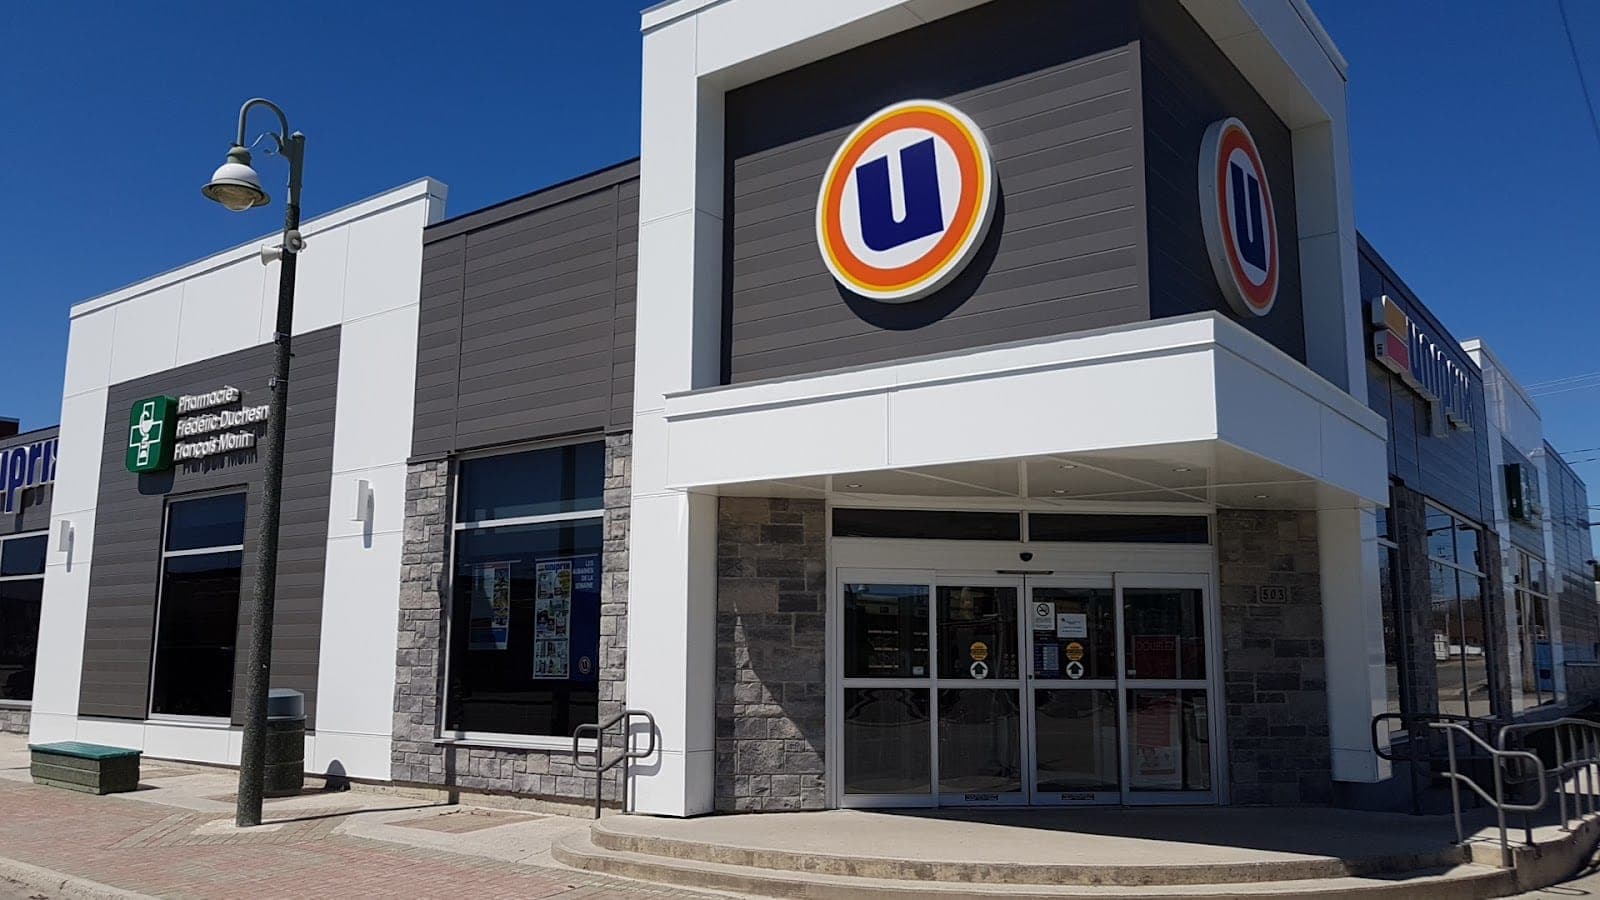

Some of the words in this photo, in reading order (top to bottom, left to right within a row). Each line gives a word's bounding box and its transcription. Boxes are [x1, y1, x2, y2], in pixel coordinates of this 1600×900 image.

[178, 386, 237, 413] Pharmacie
[174, 437, 218, 460] François
[219, 431, 252, 452] Morin
[1263, 589, 1285, 600] 503
